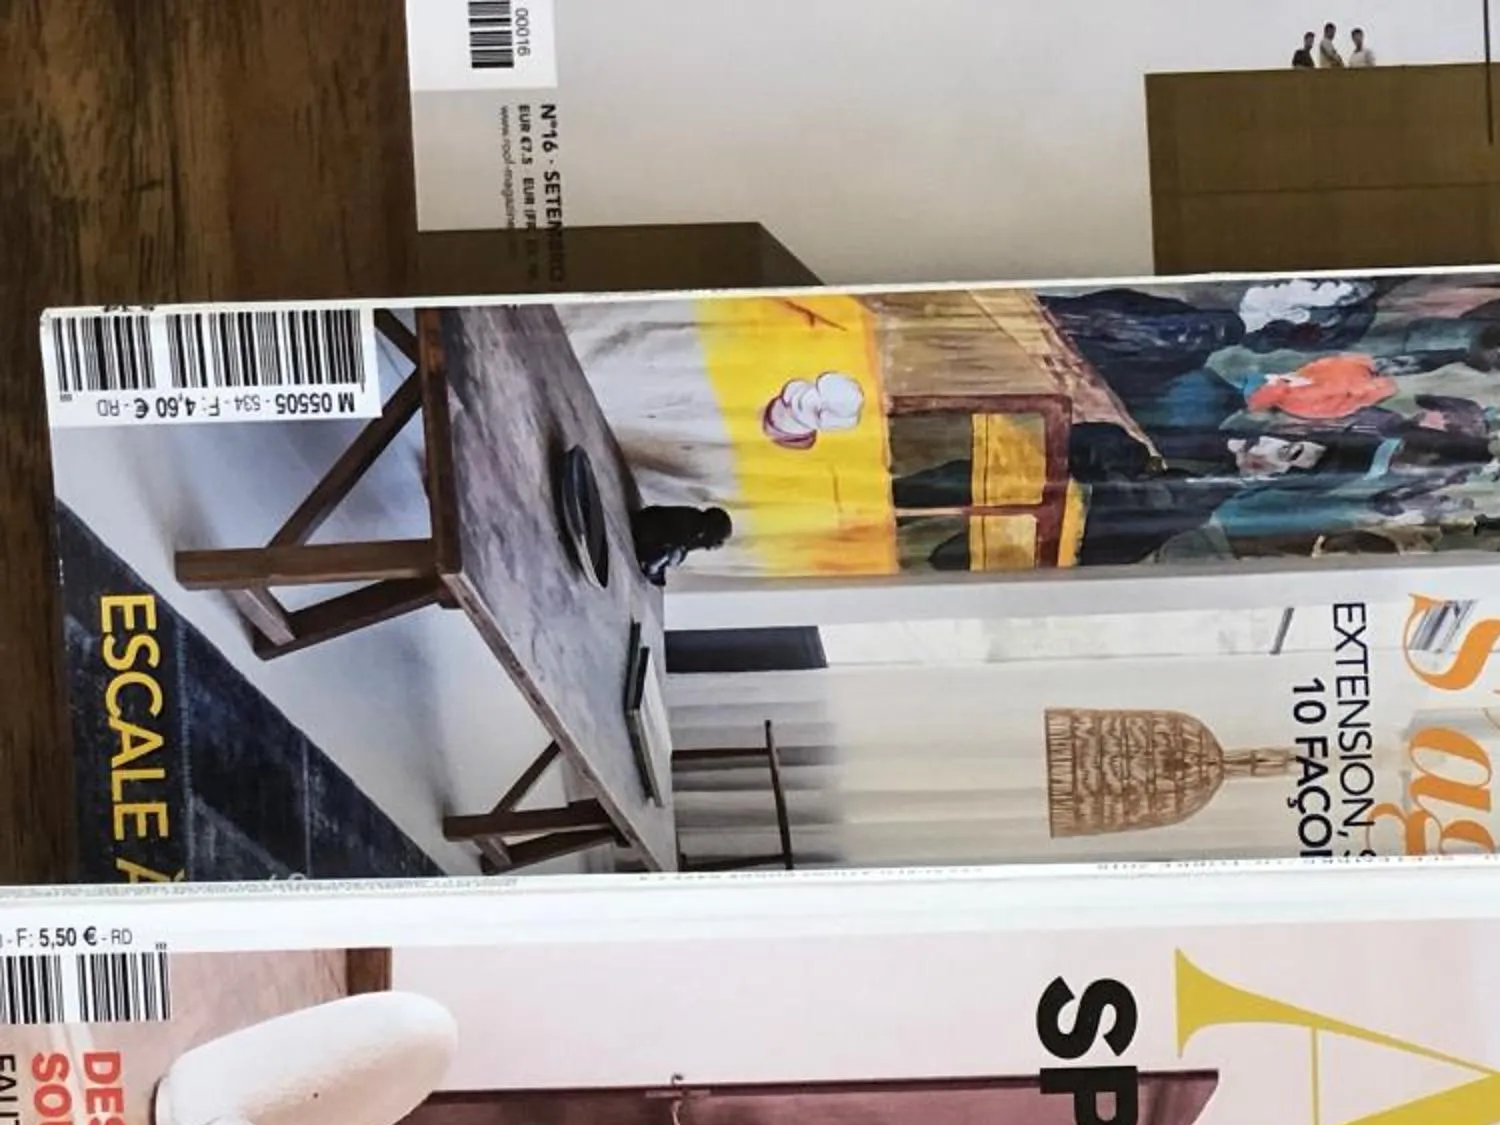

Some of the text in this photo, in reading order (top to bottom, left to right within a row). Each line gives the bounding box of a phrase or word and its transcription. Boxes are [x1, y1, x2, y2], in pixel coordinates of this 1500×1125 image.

[540, 104, 559, 153] N°16
[155, 396, 197, 418] 4,60
[275, 392, 333, 415] 05505
[338, 391, 356, 413] M
[101, 594, 168, 841] ESCALE
[1292, 676, 1328, 725] 10
[1331, 601, 1377, 838] EXTENSION,
[39, 927, 77, 949] 5,50
[82, 926, 98, 946] €
